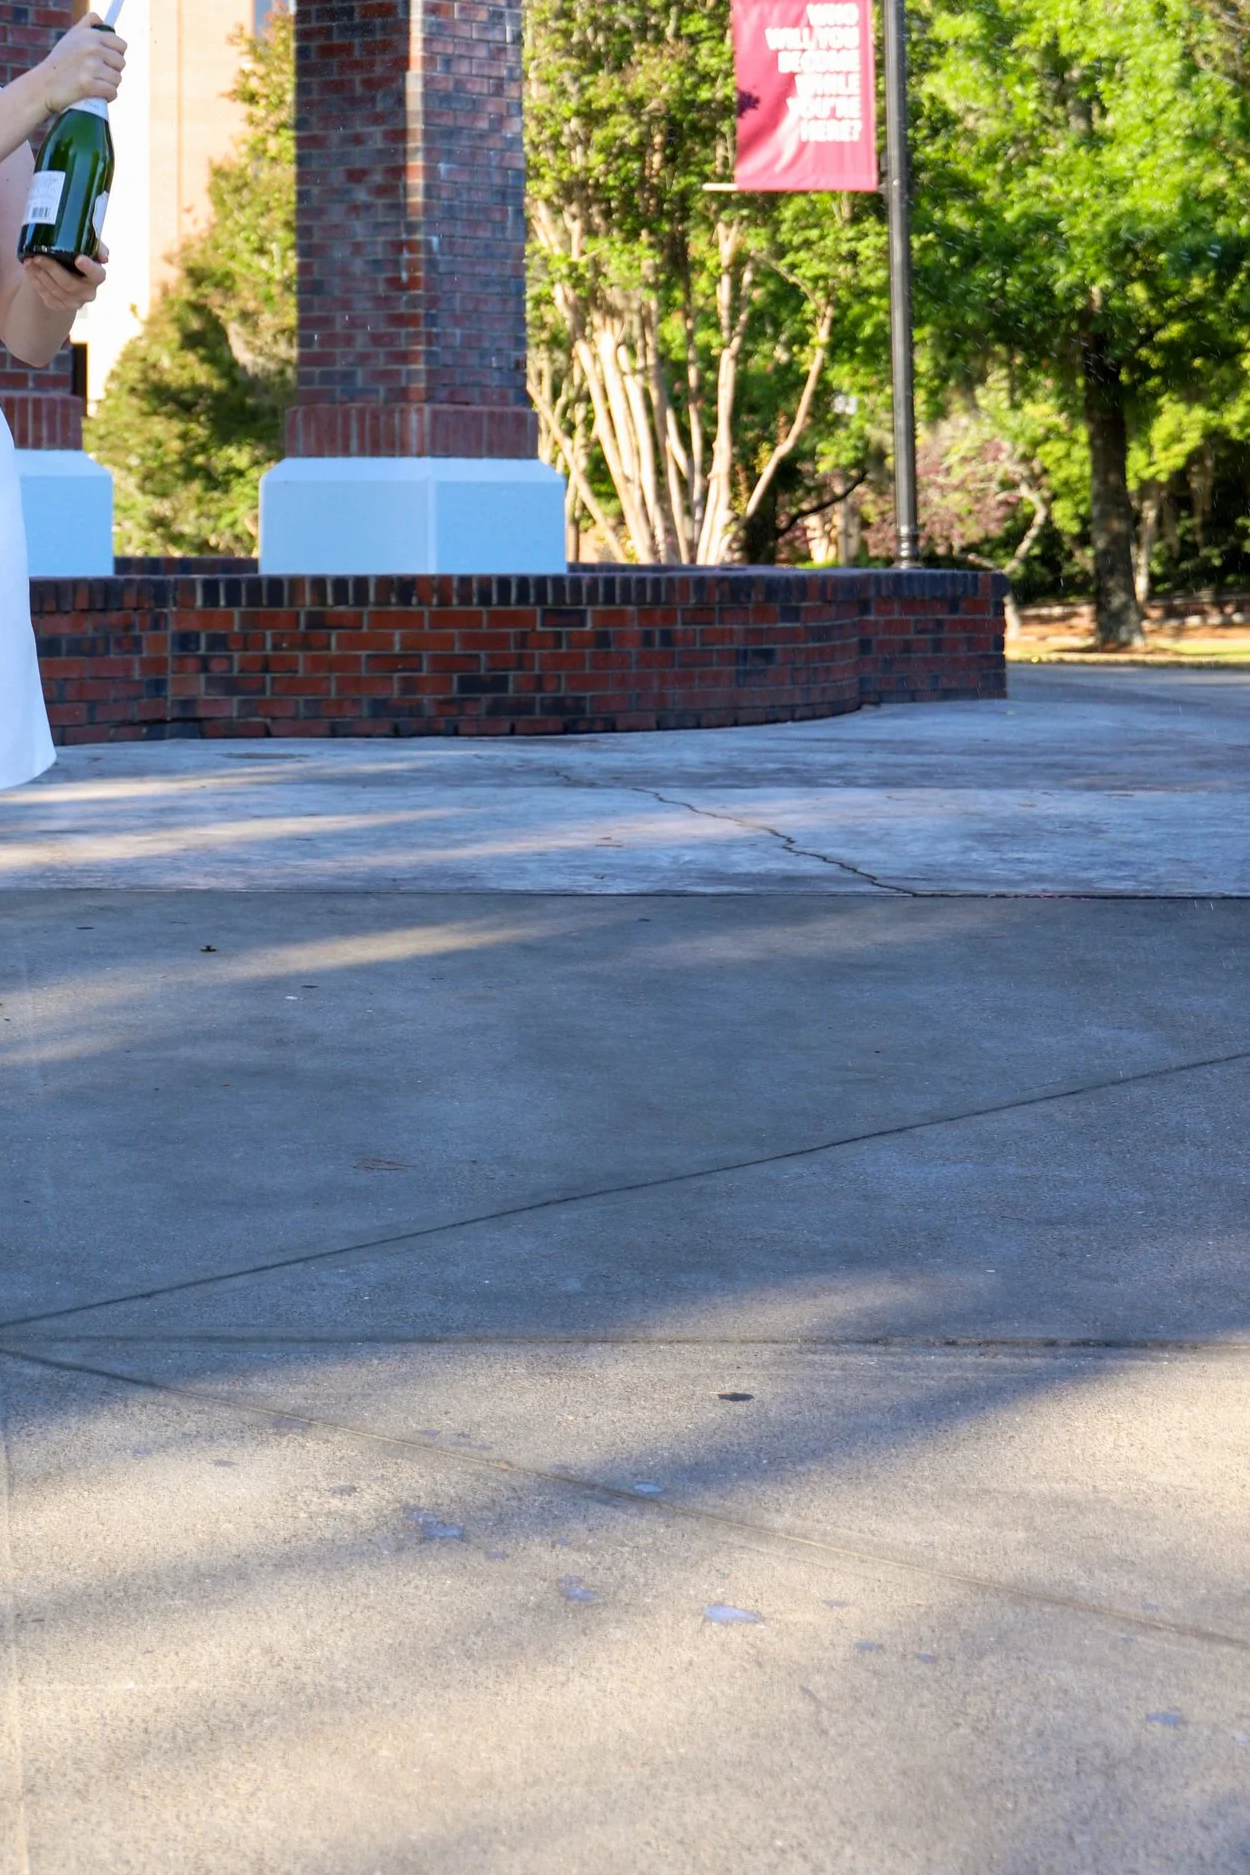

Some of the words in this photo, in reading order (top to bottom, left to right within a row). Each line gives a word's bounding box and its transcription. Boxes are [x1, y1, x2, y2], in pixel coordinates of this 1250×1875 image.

[806, 3, 859, 26] WHO
[765, 27, 812, 50] WILL
[814, 27, 859, 49] YOU
[778, 49, 860, 73] BECOME
[795, 73, 860, 96] WHILE
[786, 96, 860, 119] YOU'RE
[800, 119, 862, 142] HERE?
